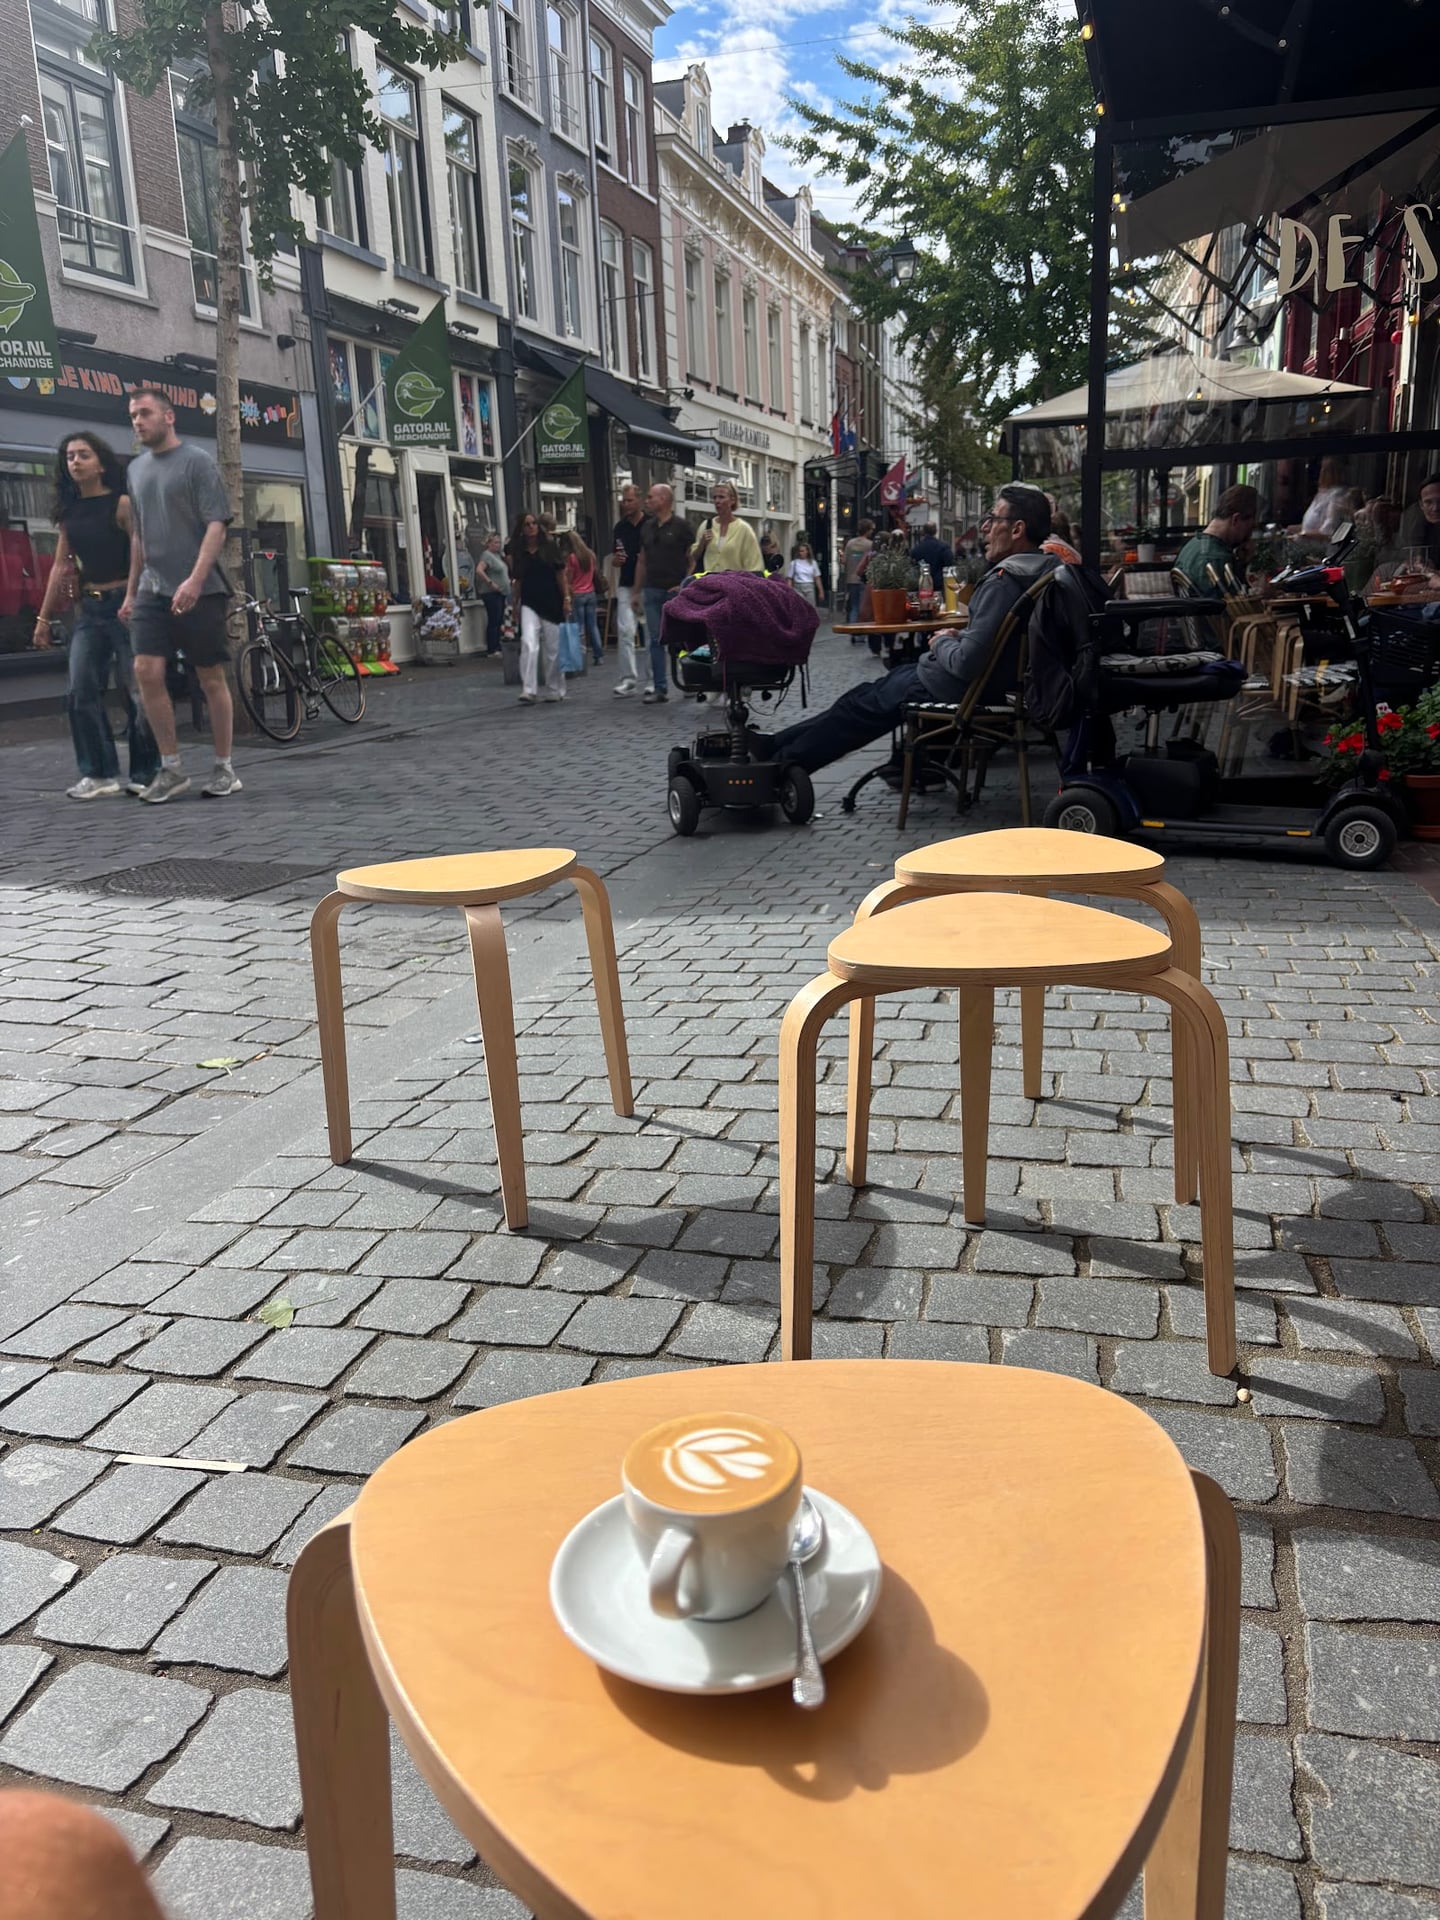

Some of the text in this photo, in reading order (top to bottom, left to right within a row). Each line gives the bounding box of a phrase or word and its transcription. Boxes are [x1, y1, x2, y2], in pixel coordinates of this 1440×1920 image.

[1277, 203, 1440, 296] DE S
[0, 340, 52, 356] OR.NL
[0, 357, 54, 369] CHANDISE
[78, 367, 123, 396] KIND
[393, 422, 451, 434] GATOR.NL
[394, 432, 451, 441] MERCHANDISE
[541, 443, 585, 452] GATOR.NL
